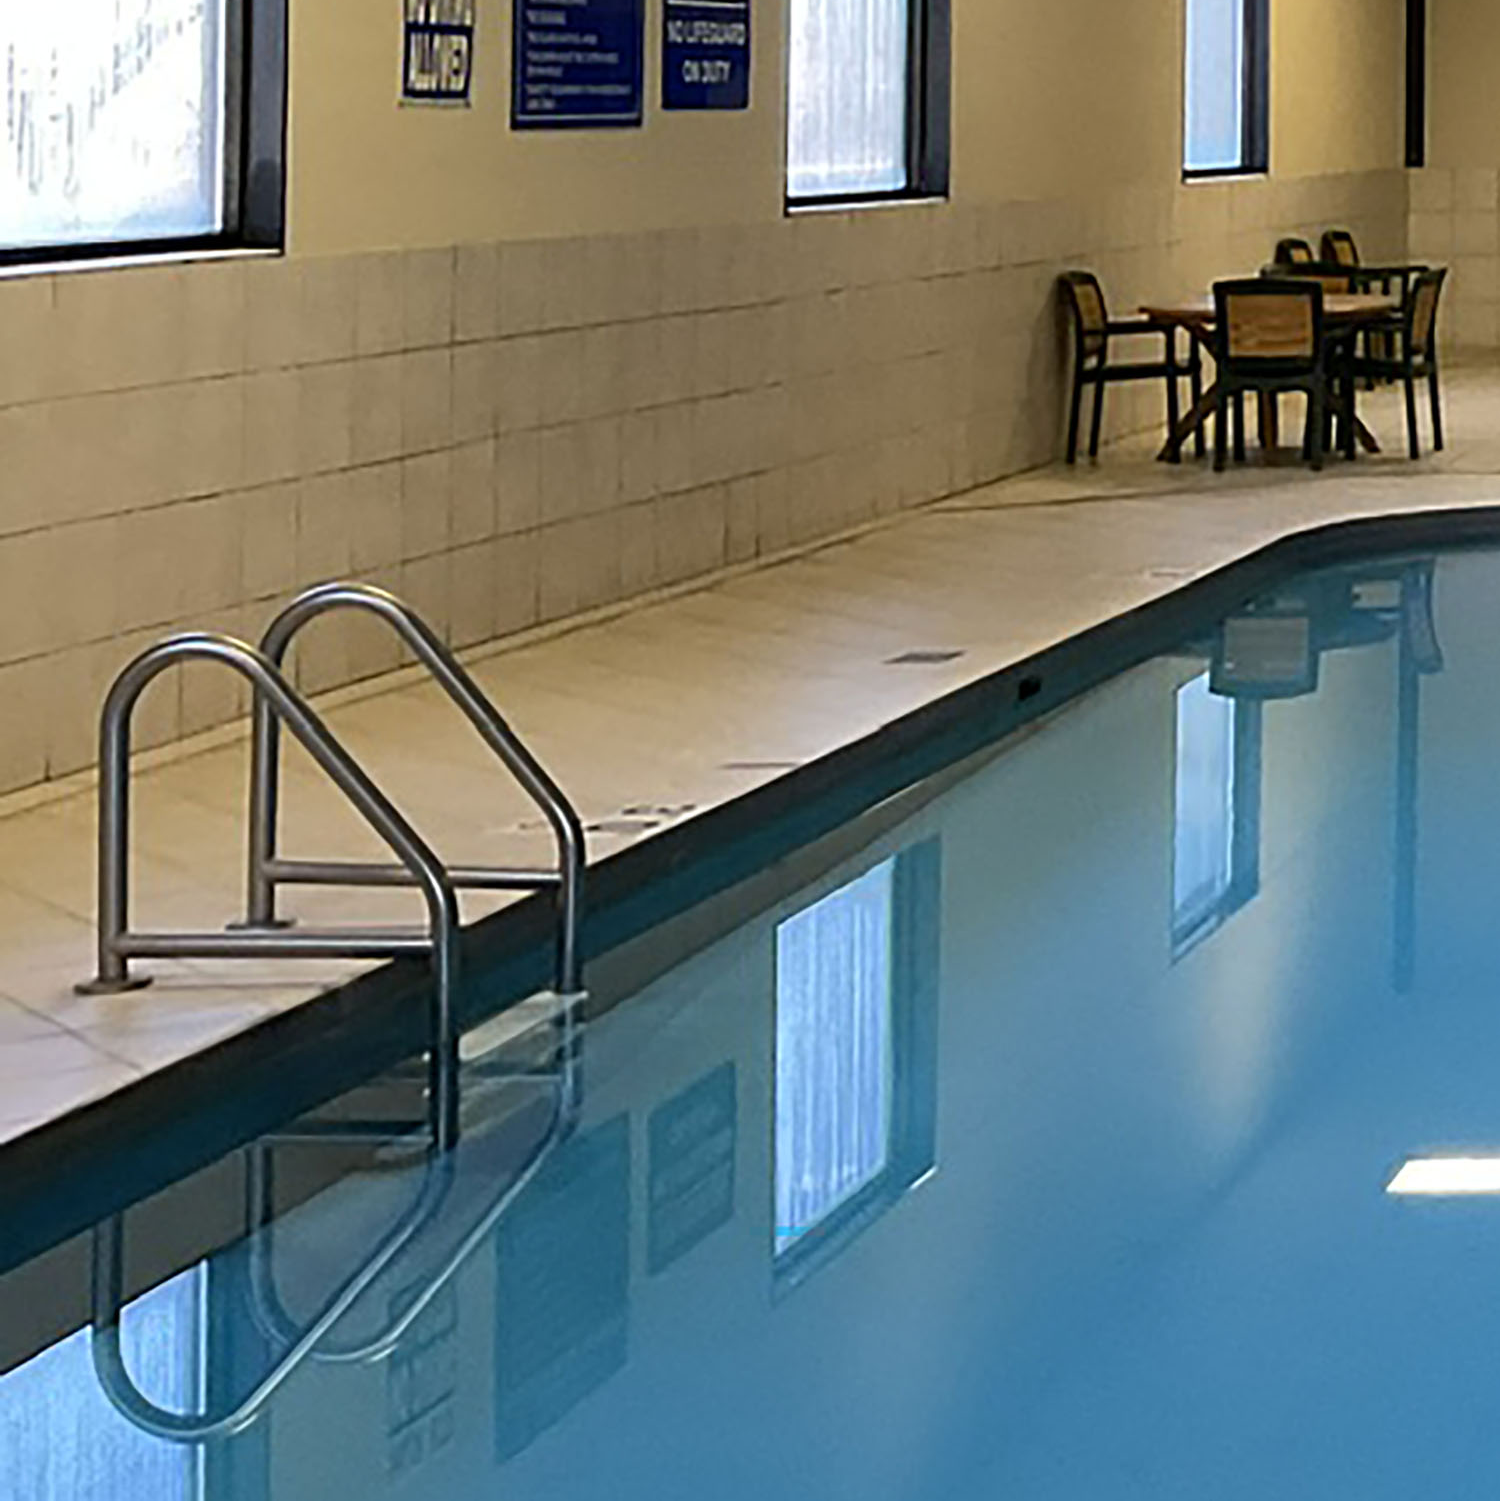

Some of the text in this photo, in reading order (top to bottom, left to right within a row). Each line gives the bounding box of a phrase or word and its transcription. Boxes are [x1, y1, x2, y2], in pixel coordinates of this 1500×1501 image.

[667, 20, 746, 46] NO LIFEGUARD
[682, 59, 731, 83] ON DUTY
